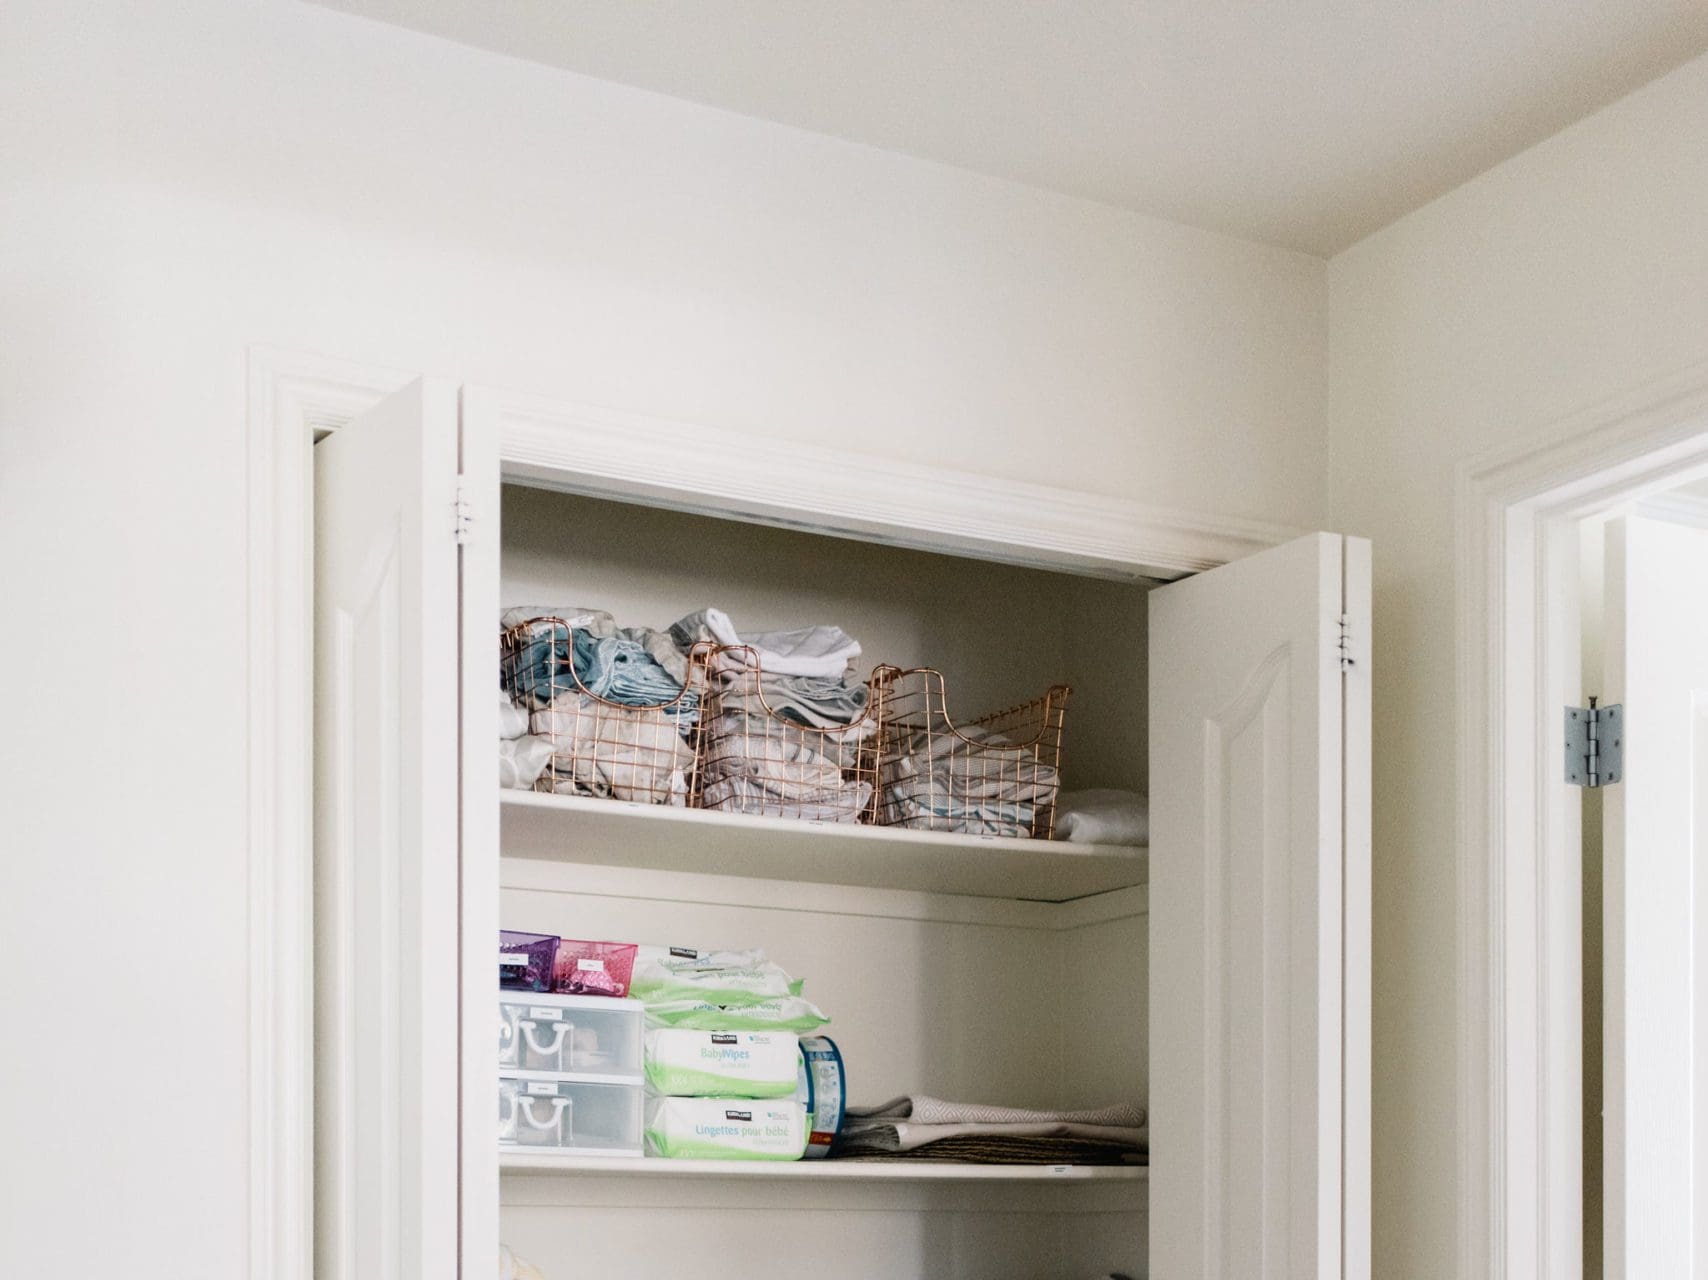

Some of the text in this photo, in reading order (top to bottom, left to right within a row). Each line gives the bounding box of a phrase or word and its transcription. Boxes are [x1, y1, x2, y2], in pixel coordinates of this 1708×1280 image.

[701, 1048, 750, 1061] BabyWipes
[696, 1125, 738, 1137] Lingettes
[741, 1127, 763, 1137] pour
